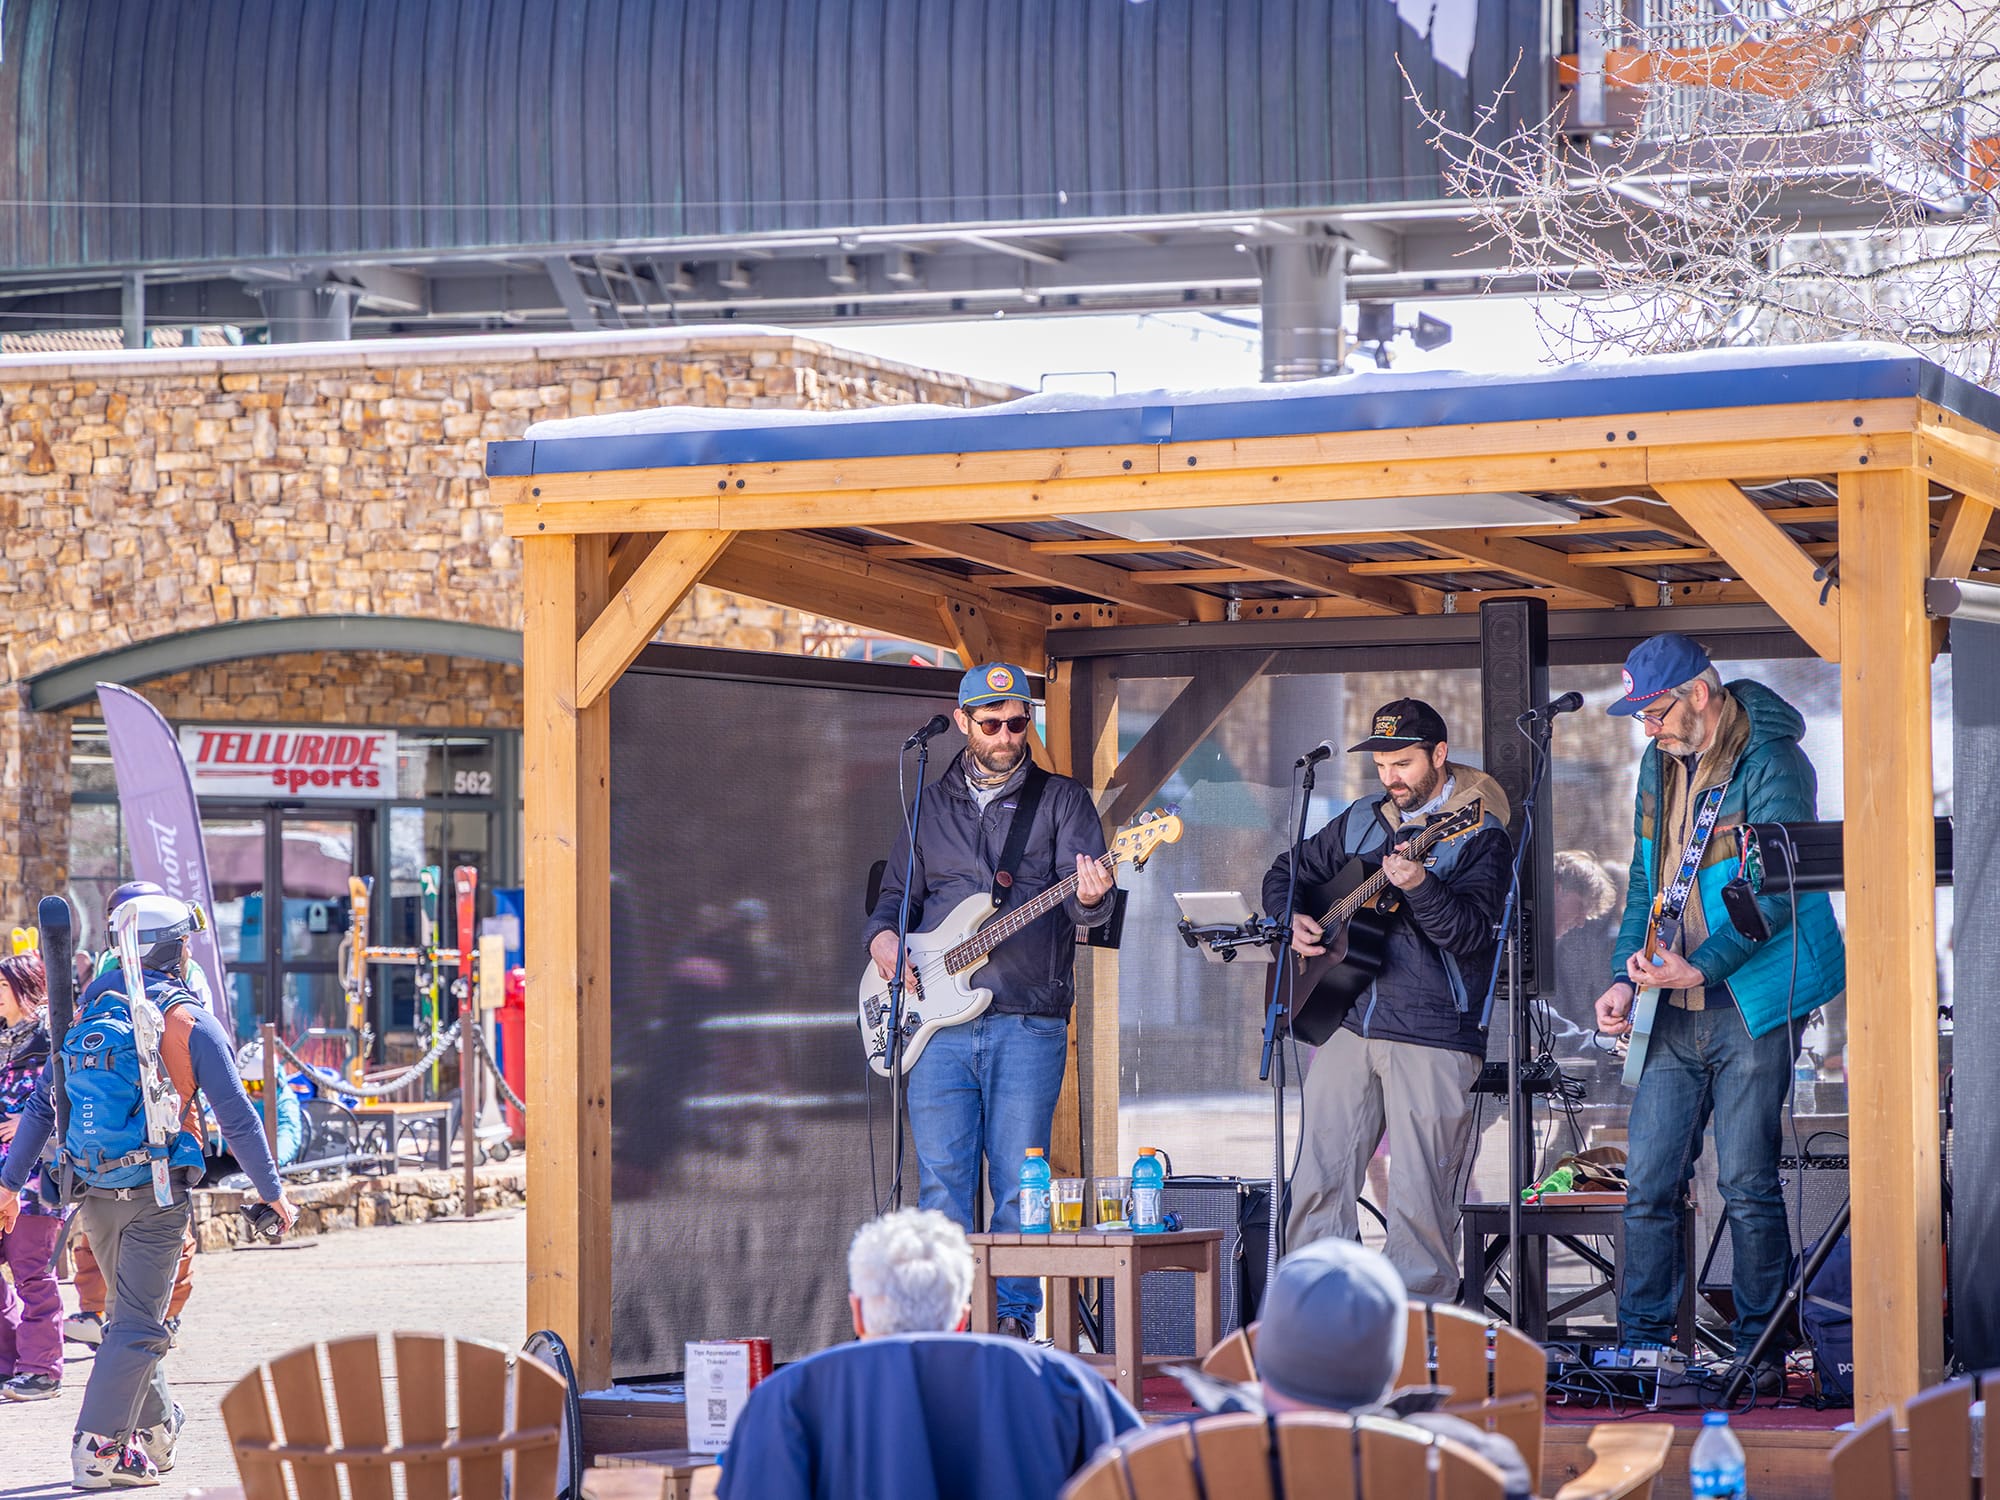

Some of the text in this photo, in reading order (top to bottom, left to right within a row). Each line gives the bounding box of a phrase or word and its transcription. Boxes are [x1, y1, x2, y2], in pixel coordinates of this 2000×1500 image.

[196, 731, 386, 766] TELLURIDE
[272, 766, 380, 793] sports
[454, 771, 493, 794] 562
